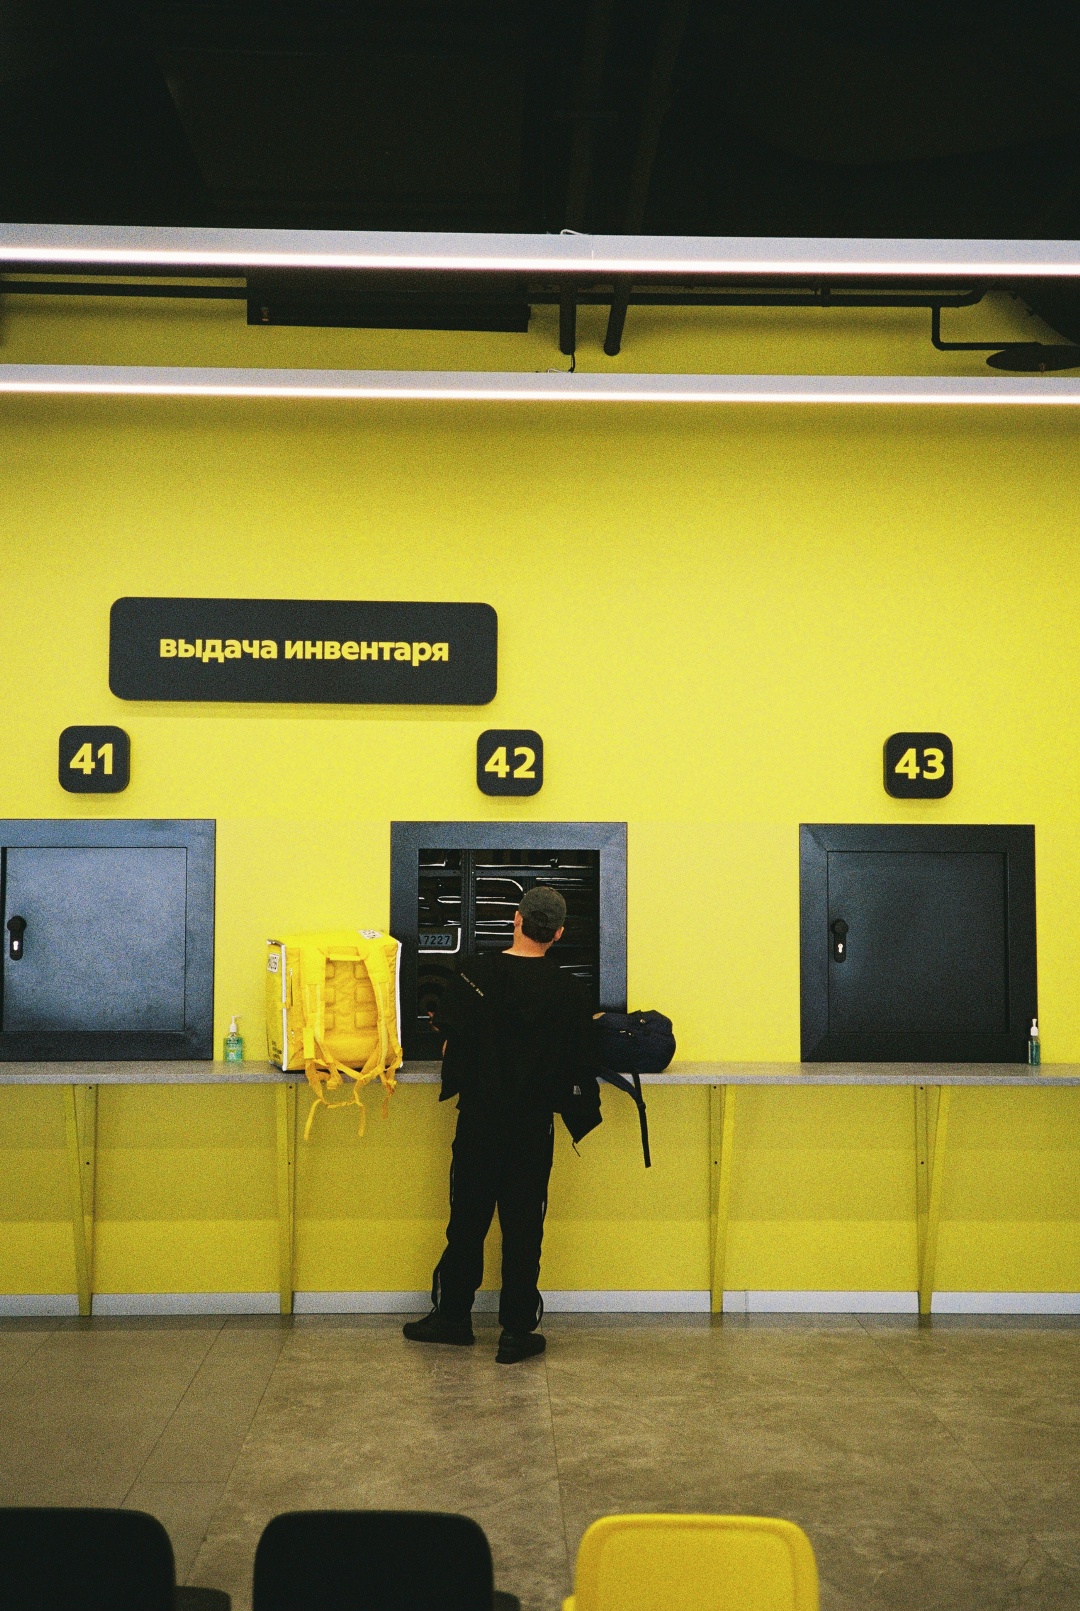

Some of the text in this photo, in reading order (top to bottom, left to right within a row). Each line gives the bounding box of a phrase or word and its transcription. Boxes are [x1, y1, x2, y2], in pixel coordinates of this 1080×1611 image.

[159, 638, 449, 667] выдача инвентаря
[69, 742, 114, 775] 41
[484, 746, 536, 779] 42
[894, 747, 945, 780] 43
